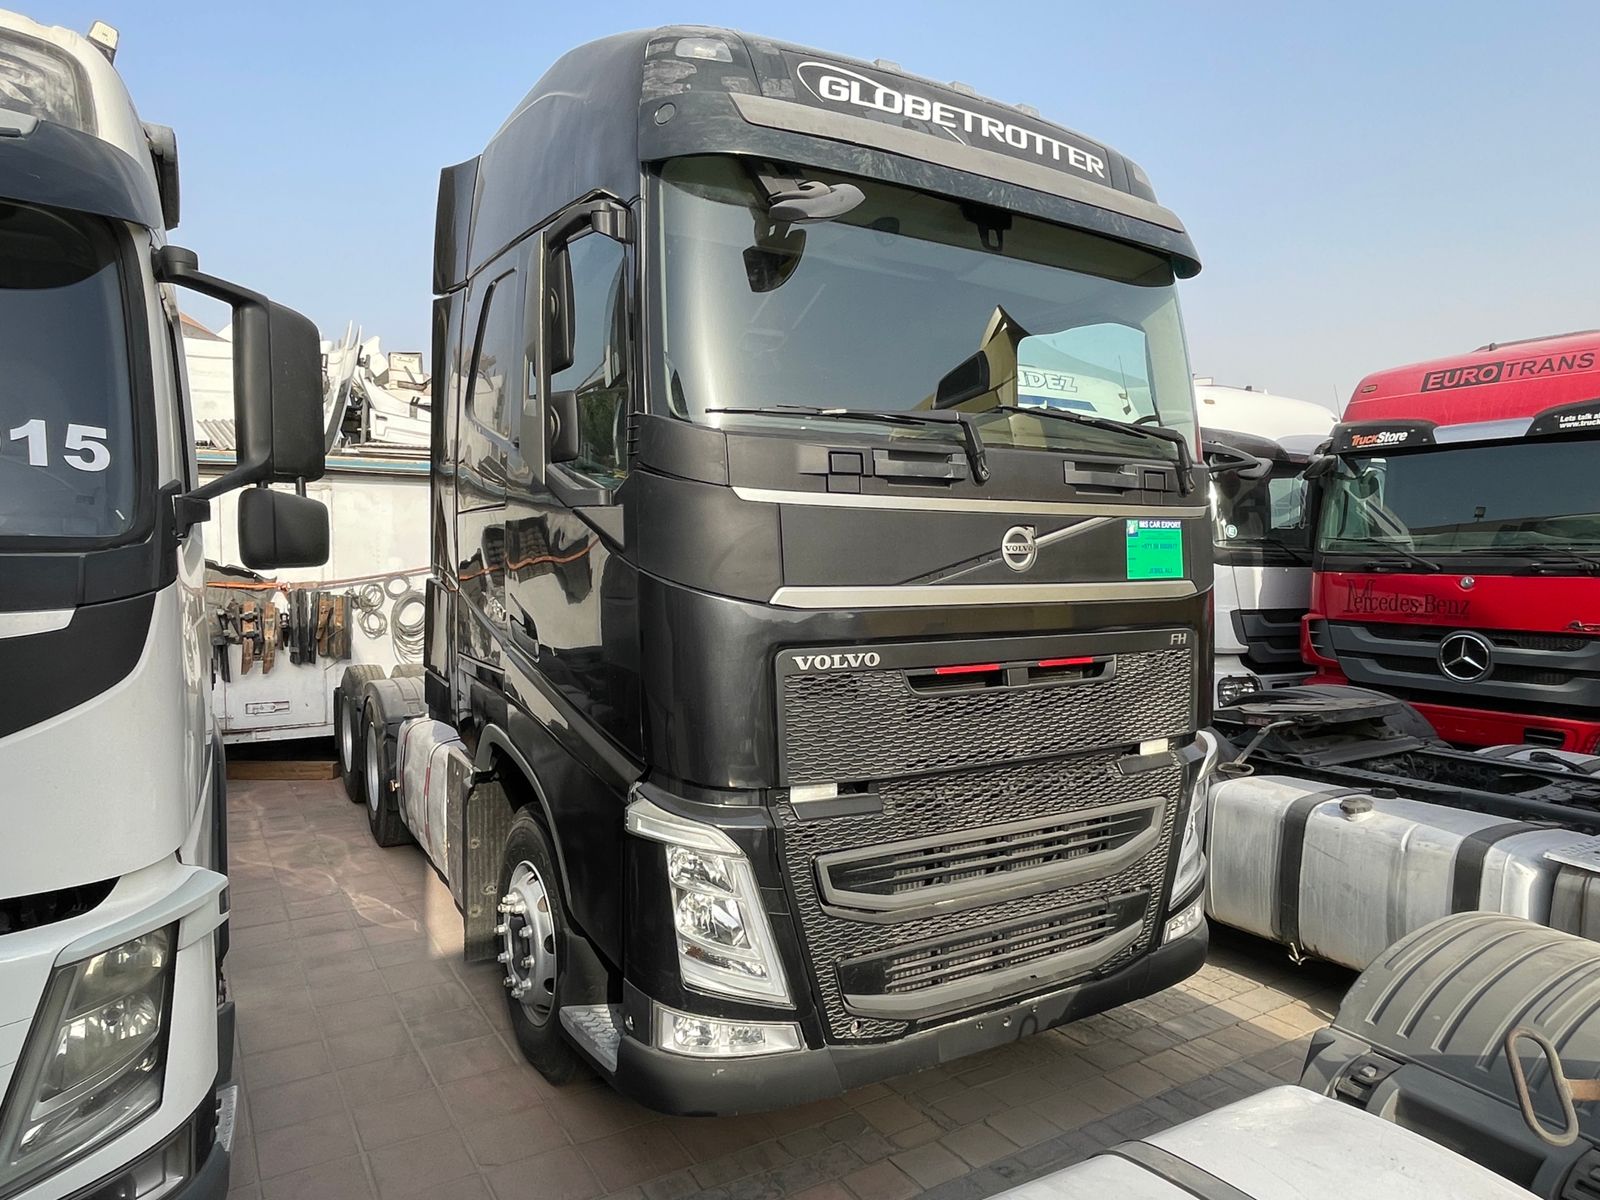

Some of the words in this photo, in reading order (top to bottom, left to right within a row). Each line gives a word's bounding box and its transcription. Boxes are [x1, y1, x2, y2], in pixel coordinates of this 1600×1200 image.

[818, 75, 1105, 179] GLOBETROTTER
[0, 418, 111, 472] 15
[1149, 520, 1161, 529] CAR
[1161, 520, 1181, 529] EXPORT
[1342, 578, 1472, 616] Mercedes-Benz
[1170, 633, 1187, 645] FH
[791, 652, 881, 671] VOLVO
